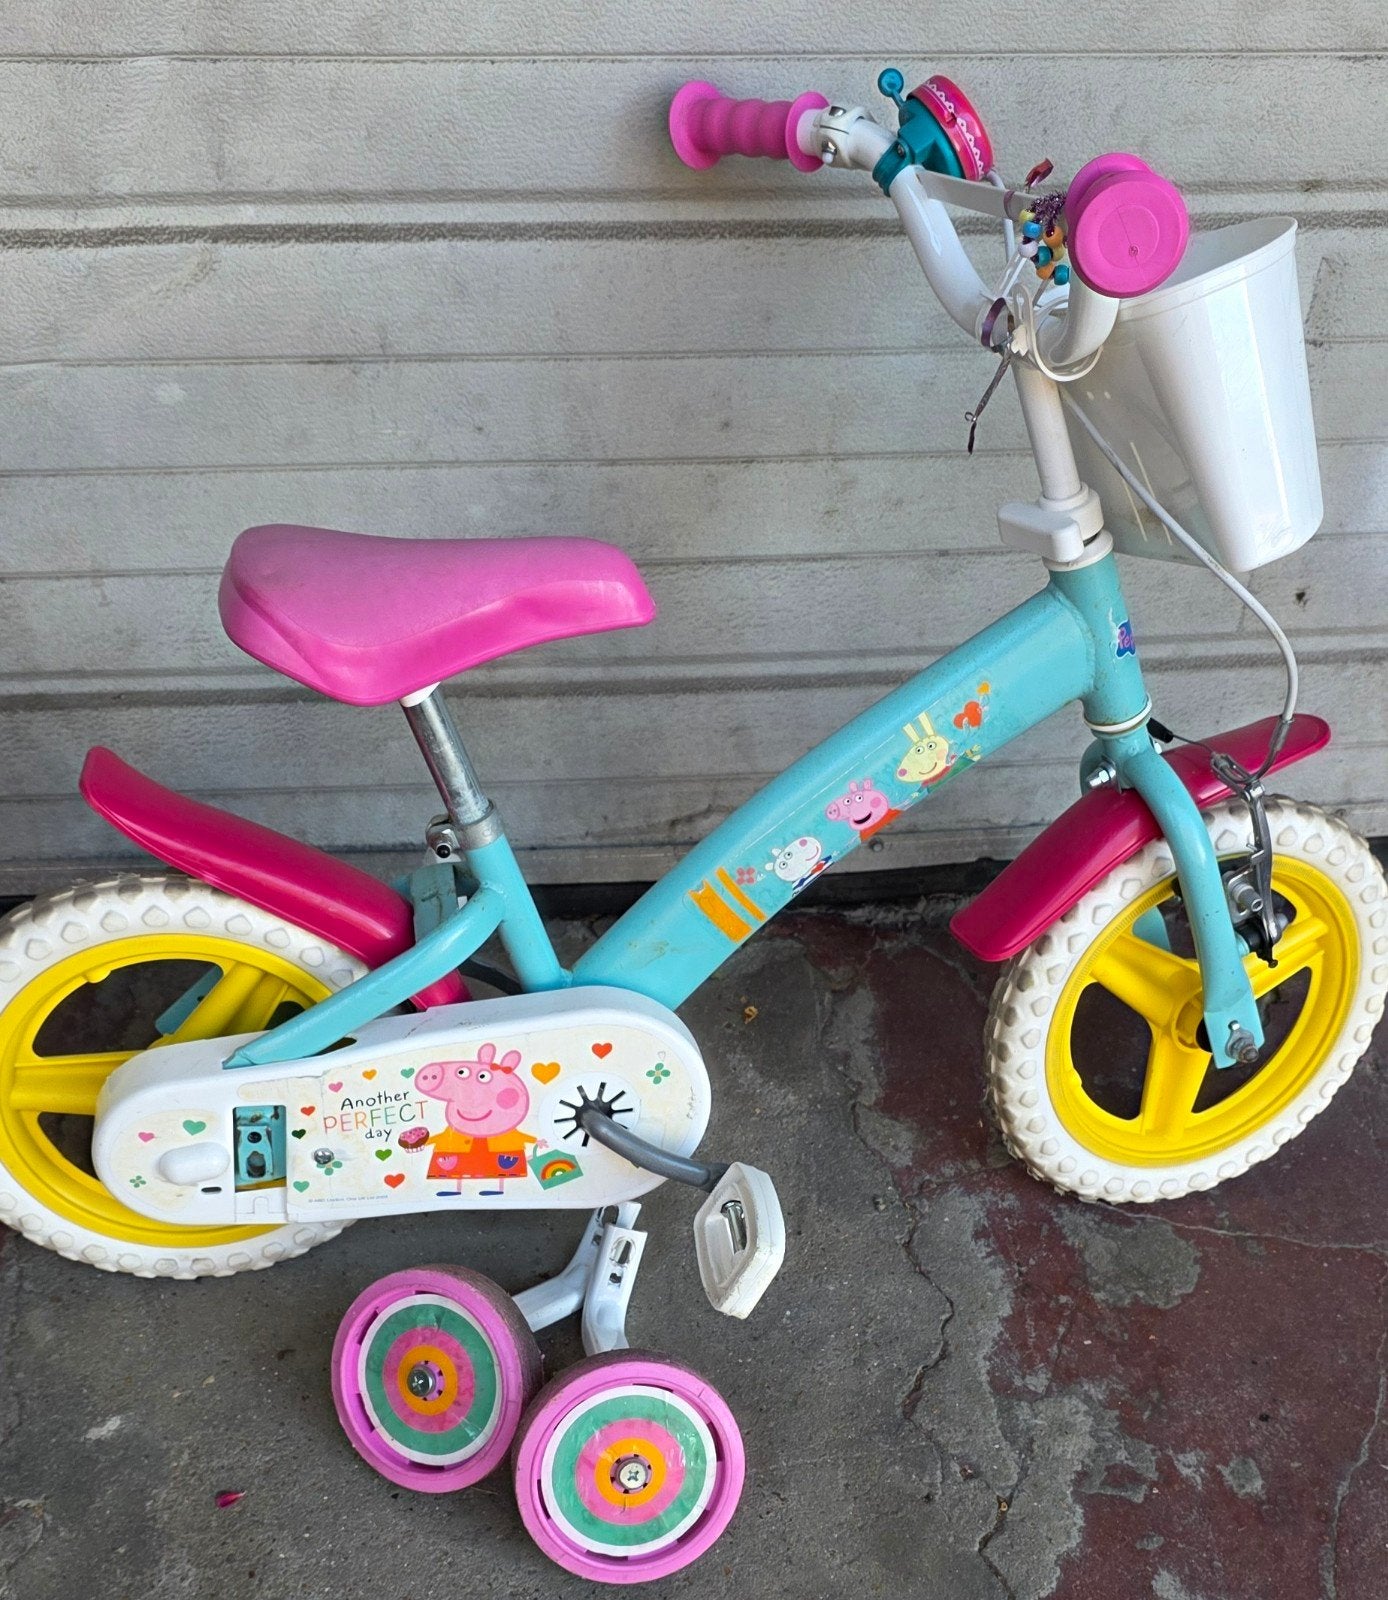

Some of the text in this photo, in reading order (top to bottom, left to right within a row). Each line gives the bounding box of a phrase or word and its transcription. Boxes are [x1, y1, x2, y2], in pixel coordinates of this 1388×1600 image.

[340, 1091, 410, 1111] Another
[323, 1101, 428, 1133] PERFECT
[364, 1127, 392, 1142] day
